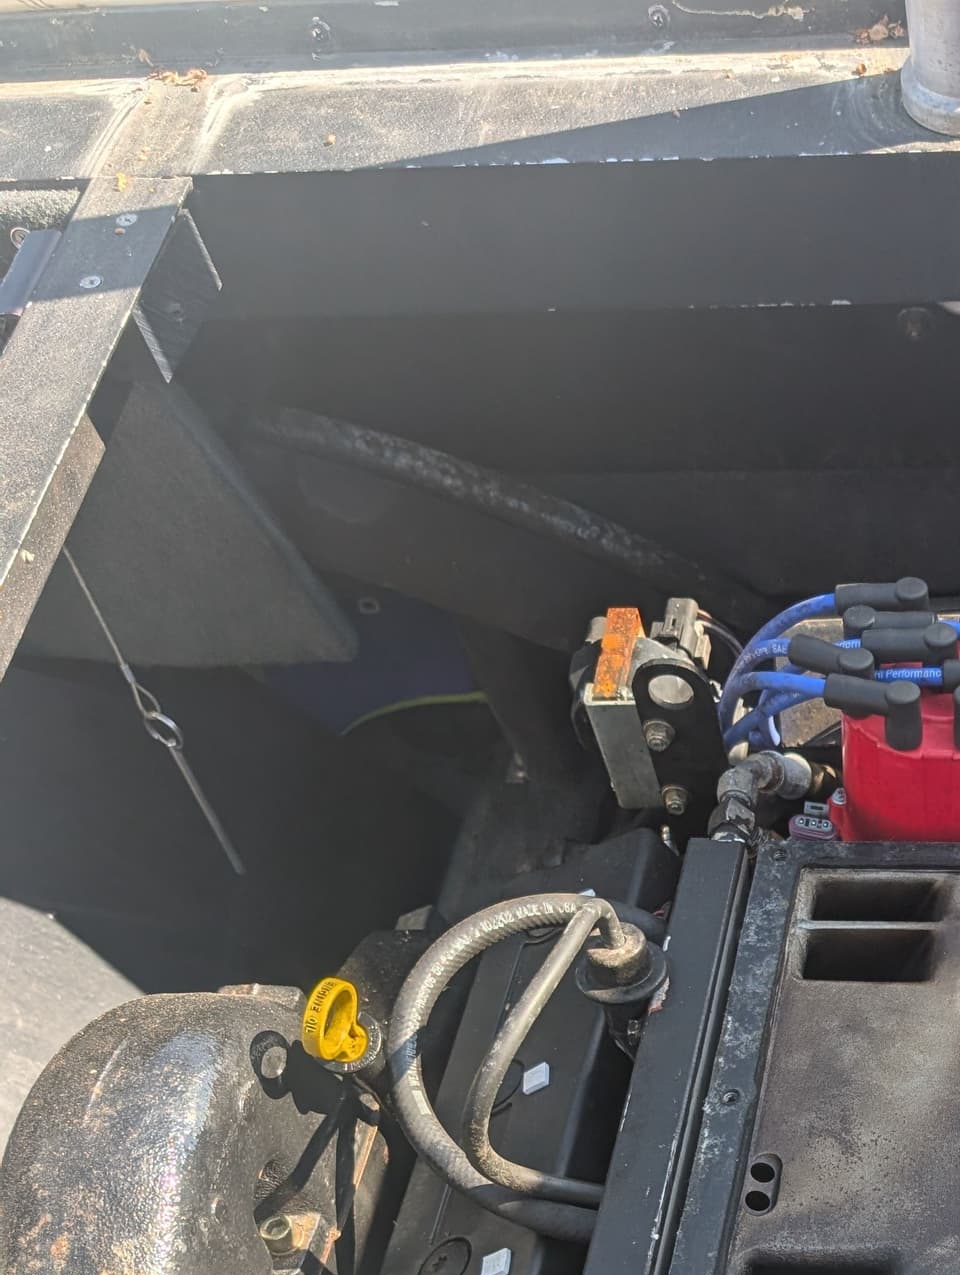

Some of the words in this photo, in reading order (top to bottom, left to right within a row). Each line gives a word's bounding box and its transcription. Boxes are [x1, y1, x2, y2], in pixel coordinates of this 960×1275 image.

[886, 668, 942, 679] Performanc
[310, 981, 336, 1014] ENGINE
[306, 1016, 319, 1033] OIL
